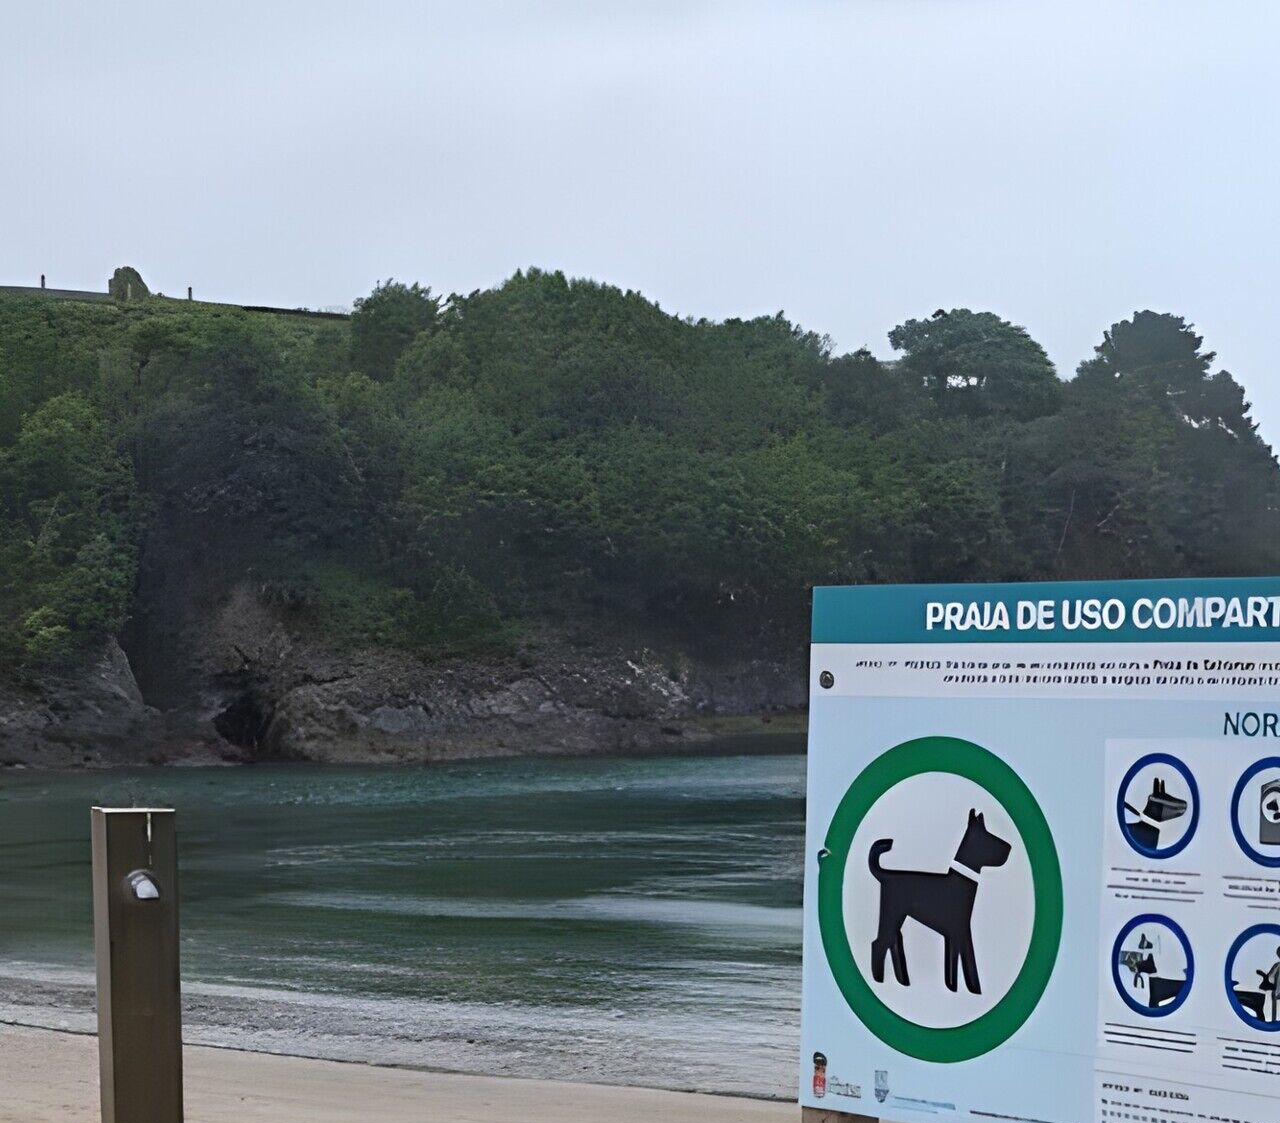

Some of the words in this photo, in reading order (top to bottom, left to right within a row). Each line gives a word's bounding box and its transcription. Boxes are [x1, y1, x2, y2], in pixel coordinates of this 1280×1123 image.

[925, 601, 1011, 631] PRAIA
[1016, 600, 1055, 630] DE
[1061, 598, 1126, 630] USO
